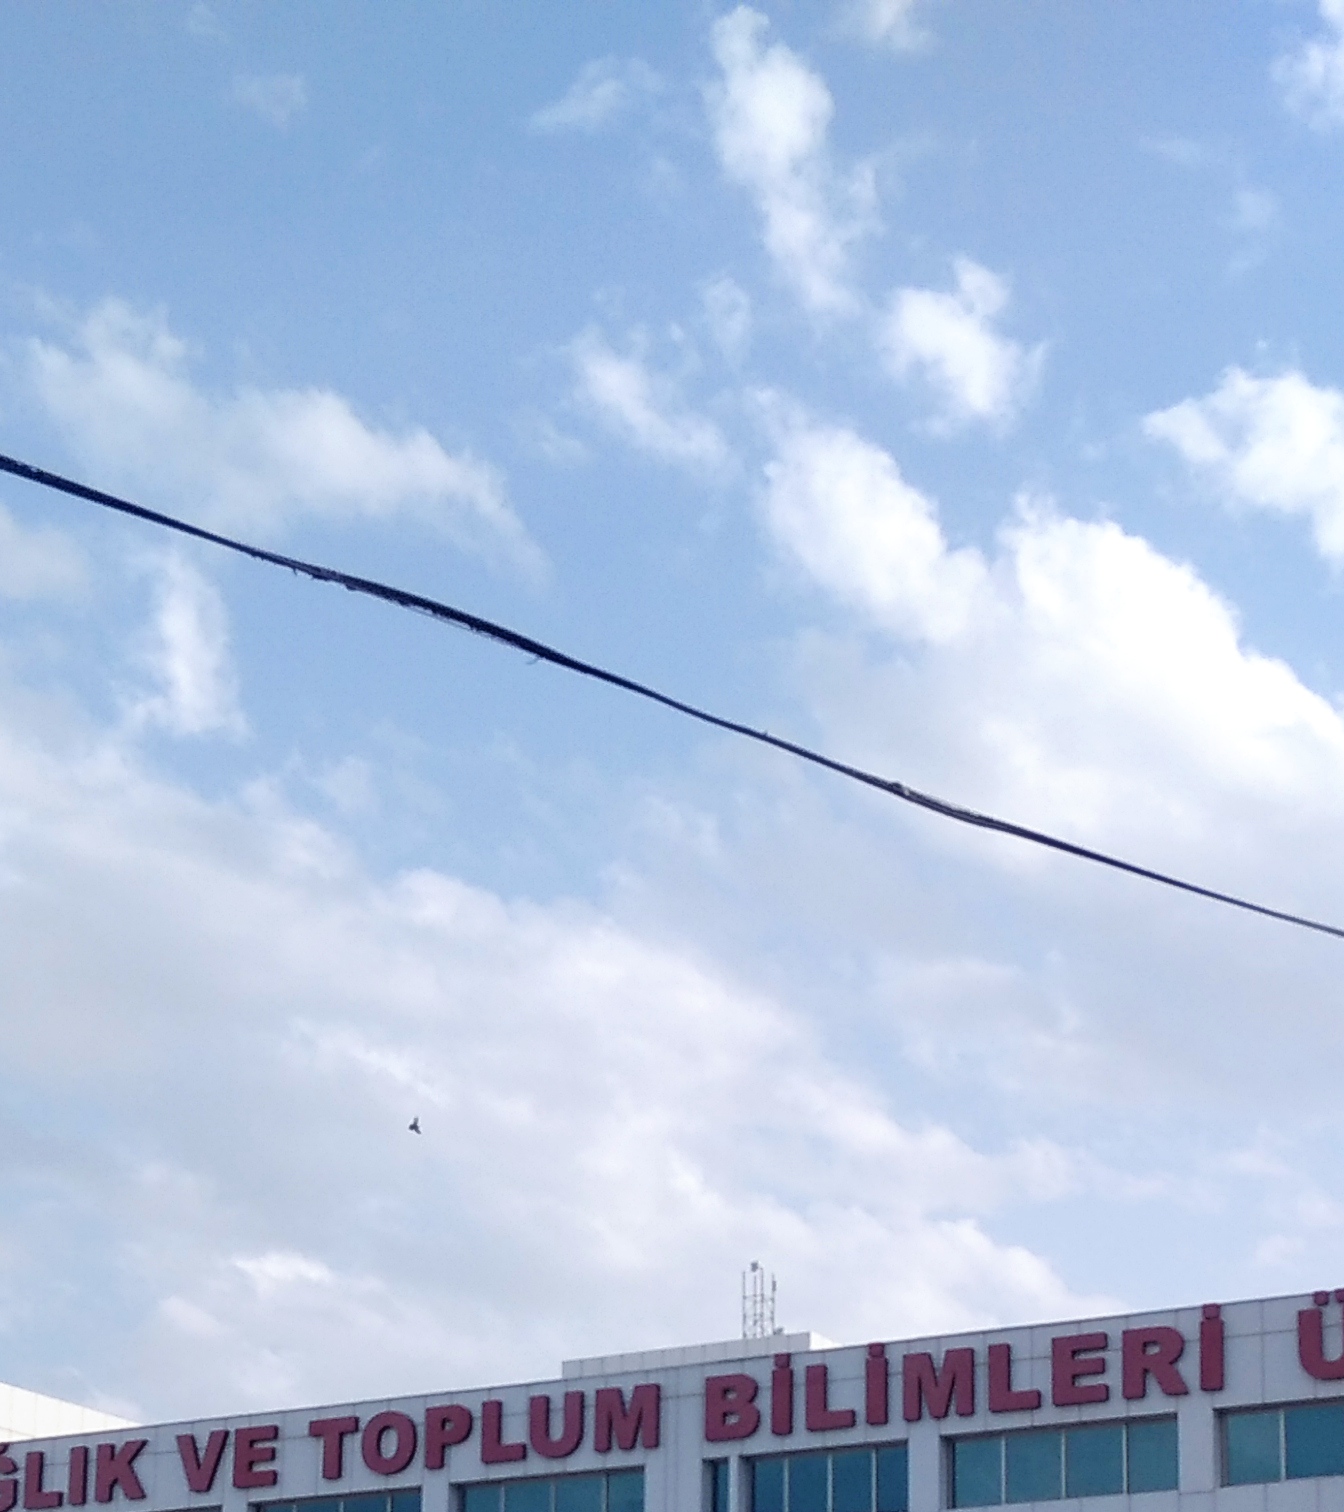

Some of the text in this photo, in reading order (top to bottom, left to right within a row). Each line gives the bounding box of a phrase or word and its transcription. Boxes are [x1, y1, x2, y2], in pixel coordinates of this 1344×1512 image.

[176, 1423, 279, 1494] VE
[309, 1382, 662, 1480] TOPLUM
[704, 1303, 1225, 1442] BİLİMLERİ
